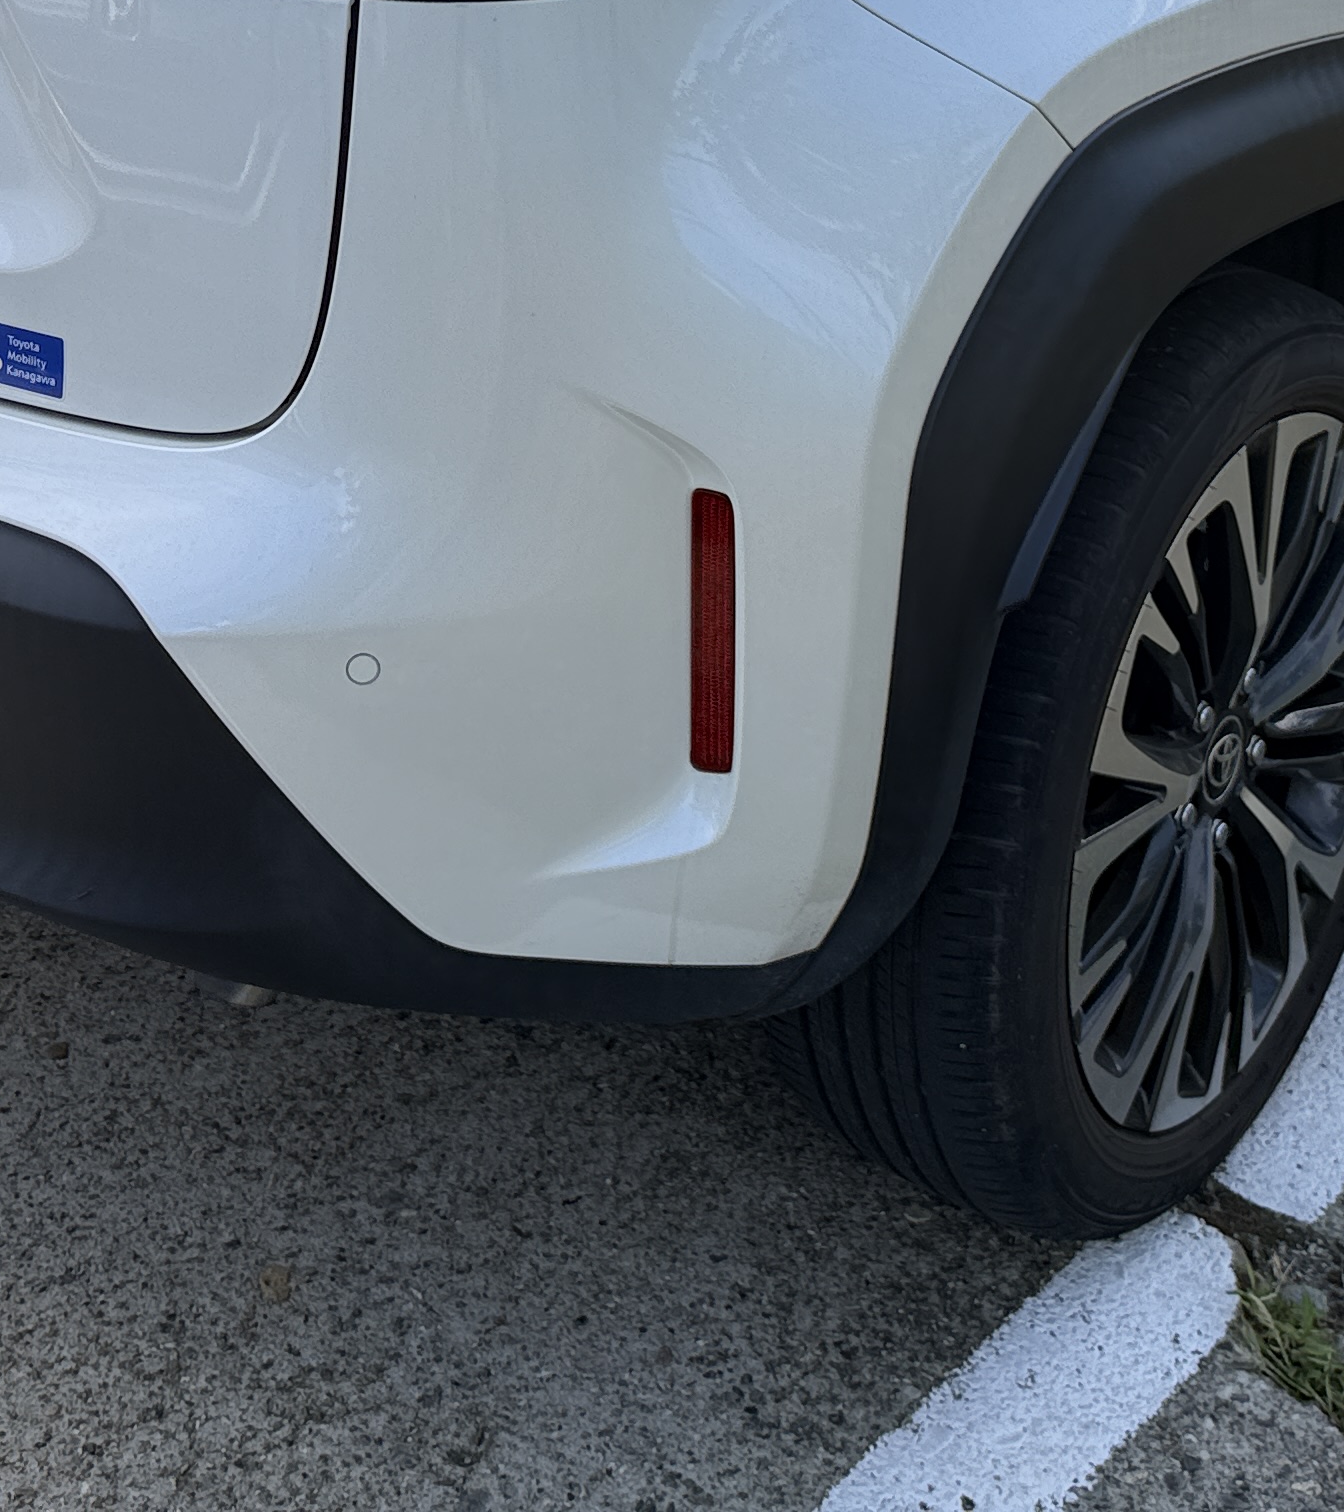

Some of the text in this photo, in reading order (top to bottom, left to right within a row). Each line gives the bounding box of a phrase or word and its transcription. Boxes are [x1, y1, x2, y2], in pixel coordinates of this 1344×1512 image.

[6, 334, 40, 353] Toyota
[6, 349, 47, 371] Mobility
[6, 364, 56, 387] Kanagawa
